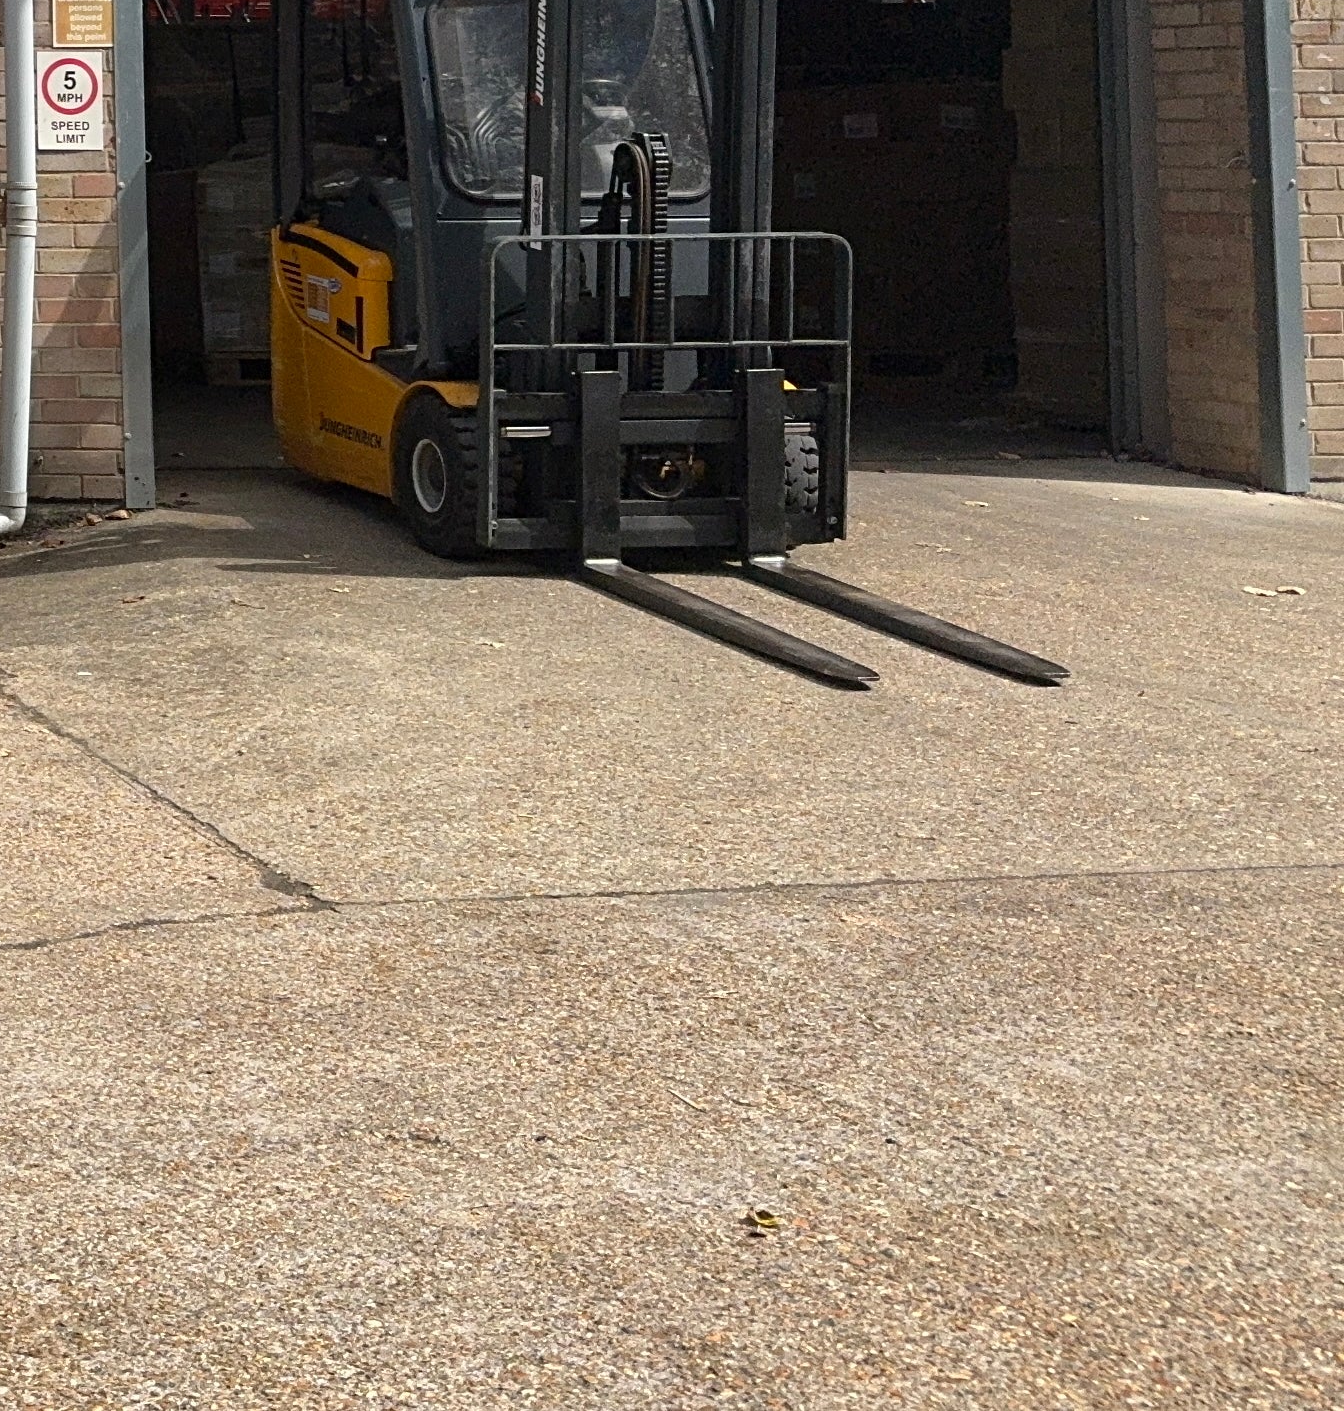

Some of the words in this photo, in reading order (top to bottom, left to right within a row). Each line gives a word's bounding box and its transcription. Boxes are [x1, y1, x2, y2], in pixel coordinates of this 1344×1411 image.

[63, 71, 76, 90] 5
[57, 93, 83, 103] MPH
[51, 121, 90, 131] SPEED
[56, 134, 85, 144] LIMIT
